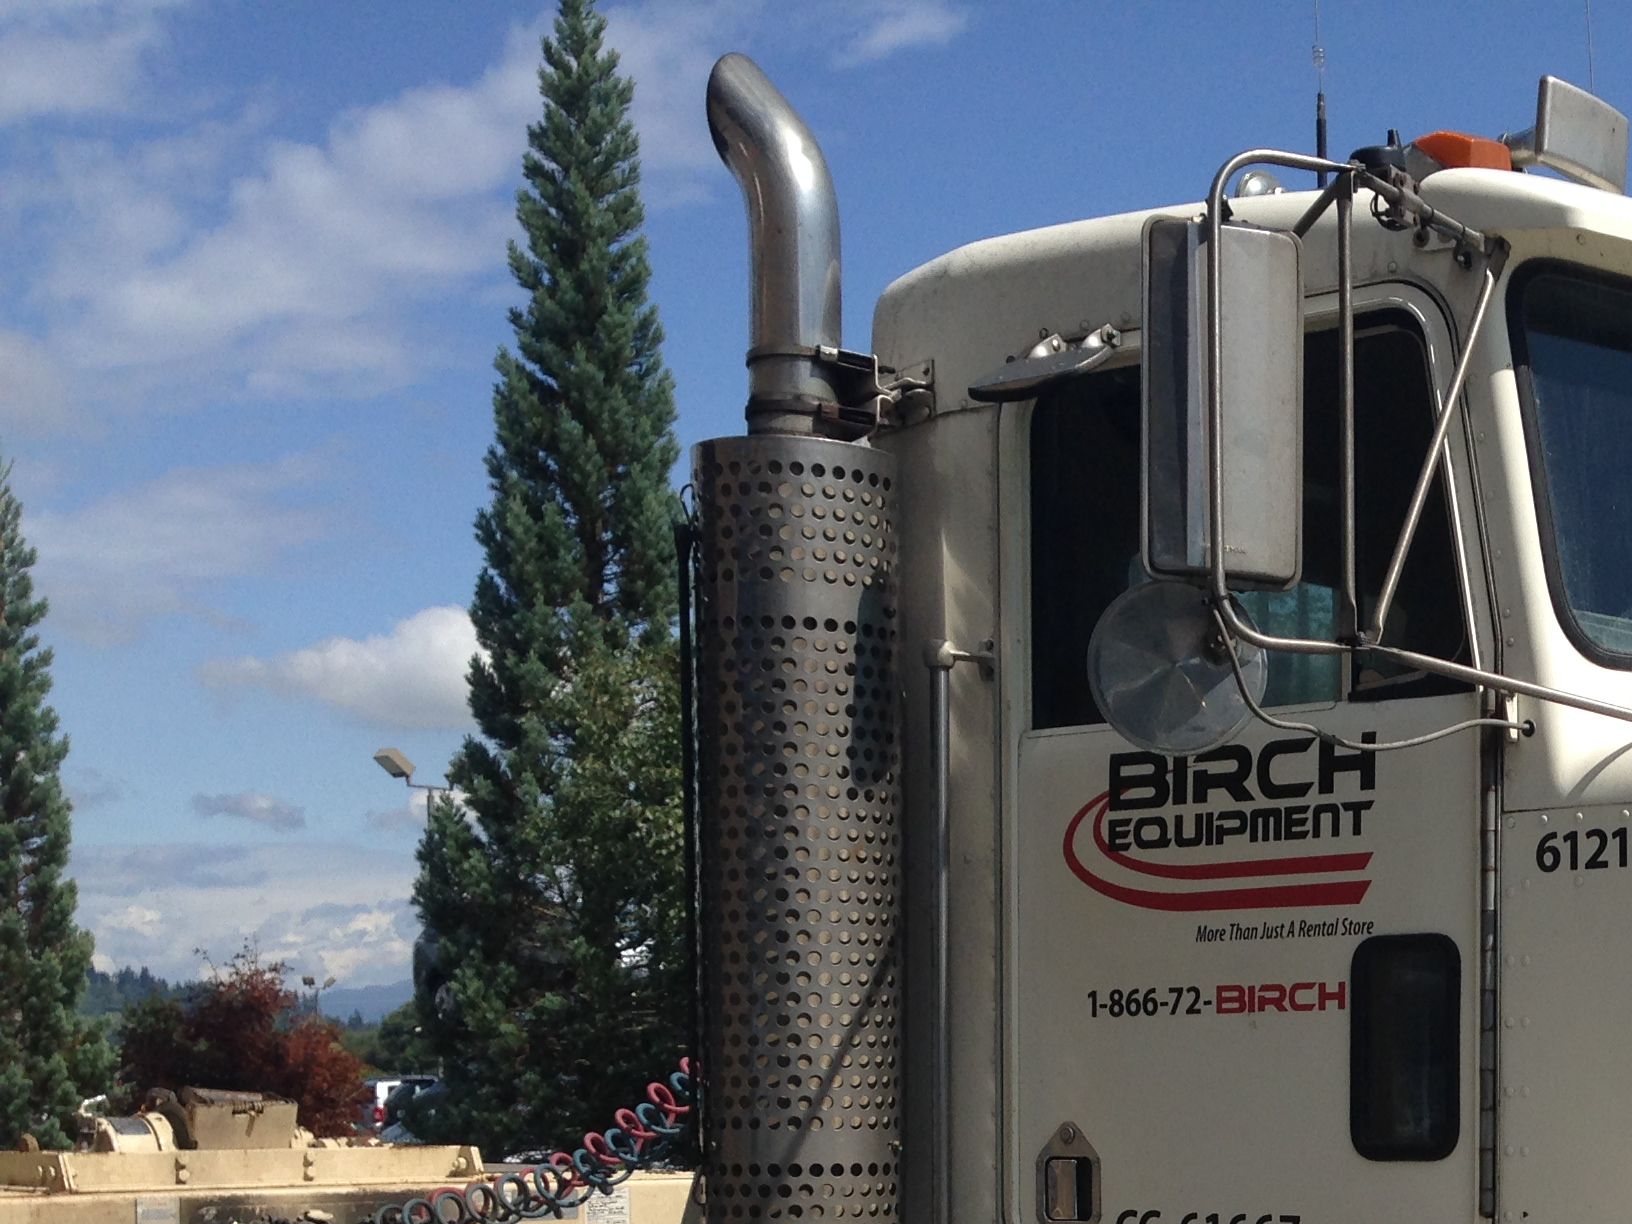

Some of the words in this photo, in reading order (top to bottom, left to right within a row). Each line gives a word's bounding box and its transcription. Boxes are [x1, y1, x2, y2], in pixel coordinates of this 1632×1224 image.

[1109, 731, 1377, 811] BIRCH
[1108, 800, 1375, 851] EQUIPMENT
[1536, 827, 1628, 872] 6121
[1195, 925, 1226, 942] More
[1229, 923, 1258, 941] Than
[1260, 922, 1285, 940] Just
[1287, 920, 1295, 938] A
[1299, 918, 1339, 937] Rental
[1342, 917, 1374, 936] Store
[1088, 981, 1346, 1018] 1-866-72-BIRCH
